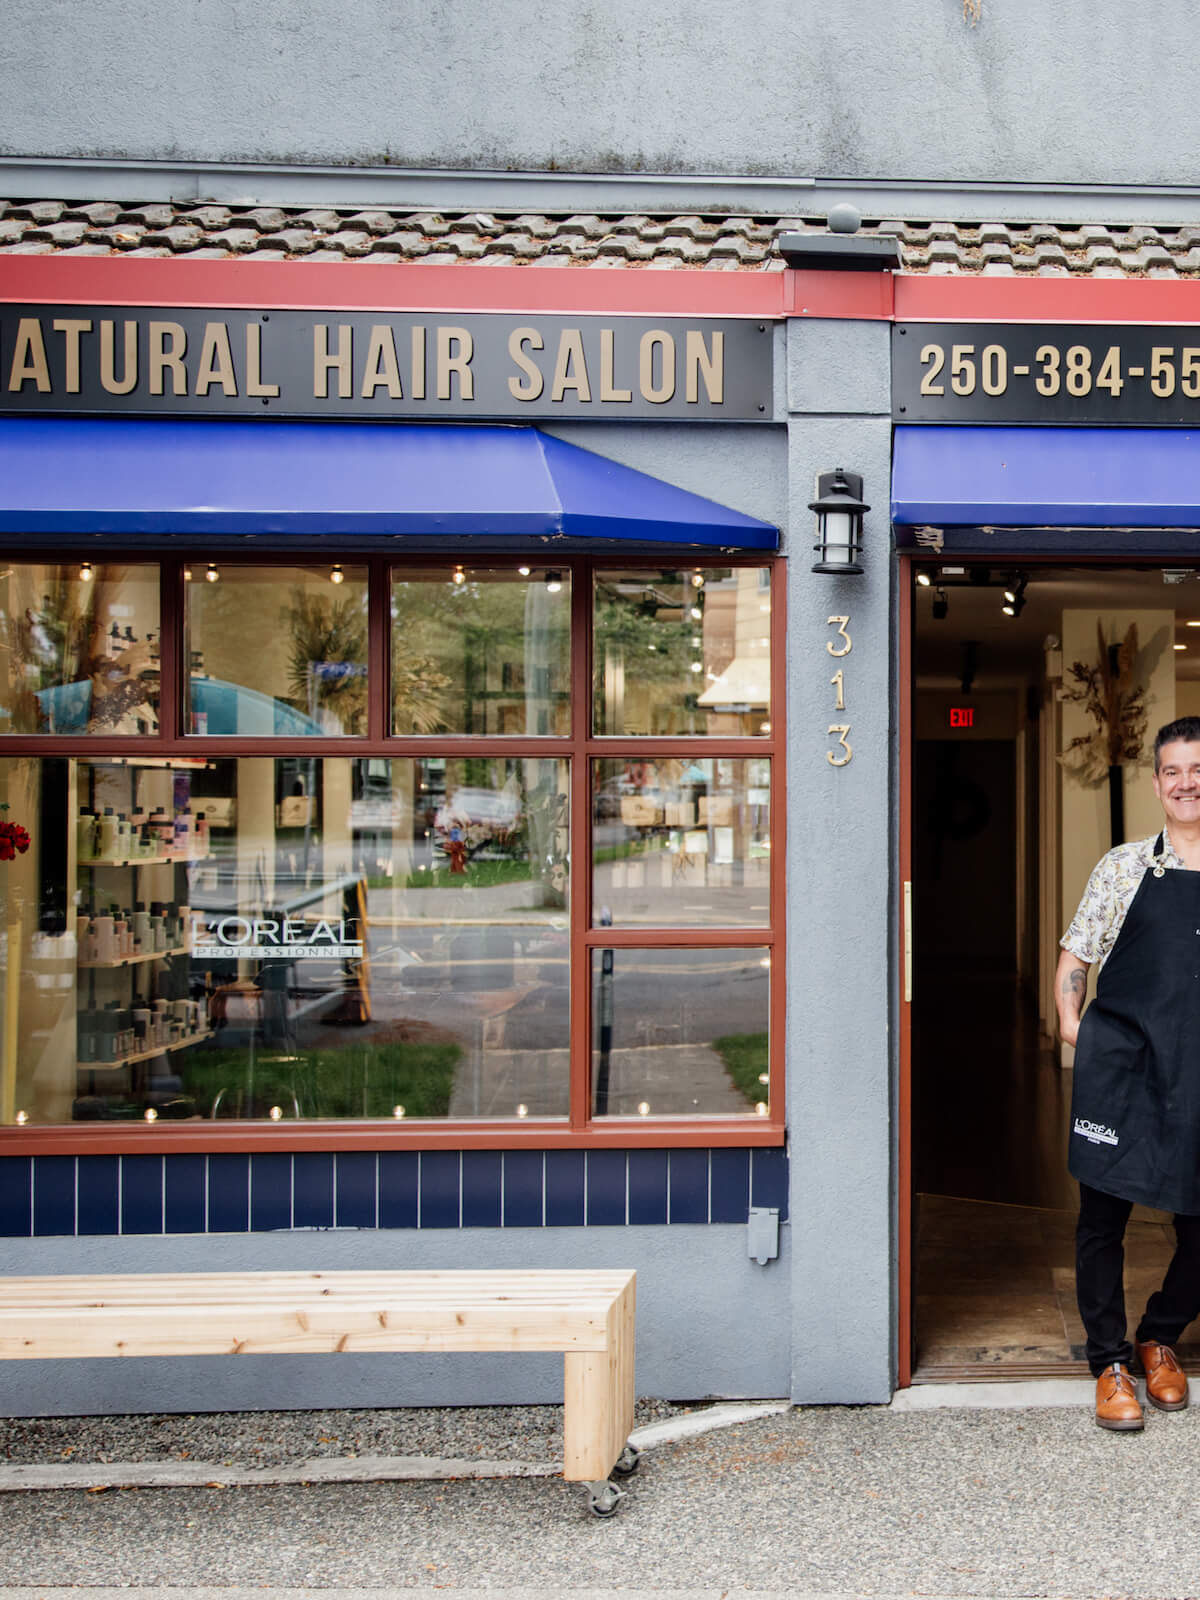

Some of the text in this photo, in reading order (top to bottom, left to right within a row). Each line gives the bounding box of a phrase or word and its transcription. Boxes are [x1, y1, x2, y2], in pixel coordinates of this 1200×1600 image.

[313, 325, 474, 400] HAIR
[507, 327, 725, 404] SALON
[950, 708, 974, 728] EXIT
[194, 946, 362, 957] PROFESSIONNEL
